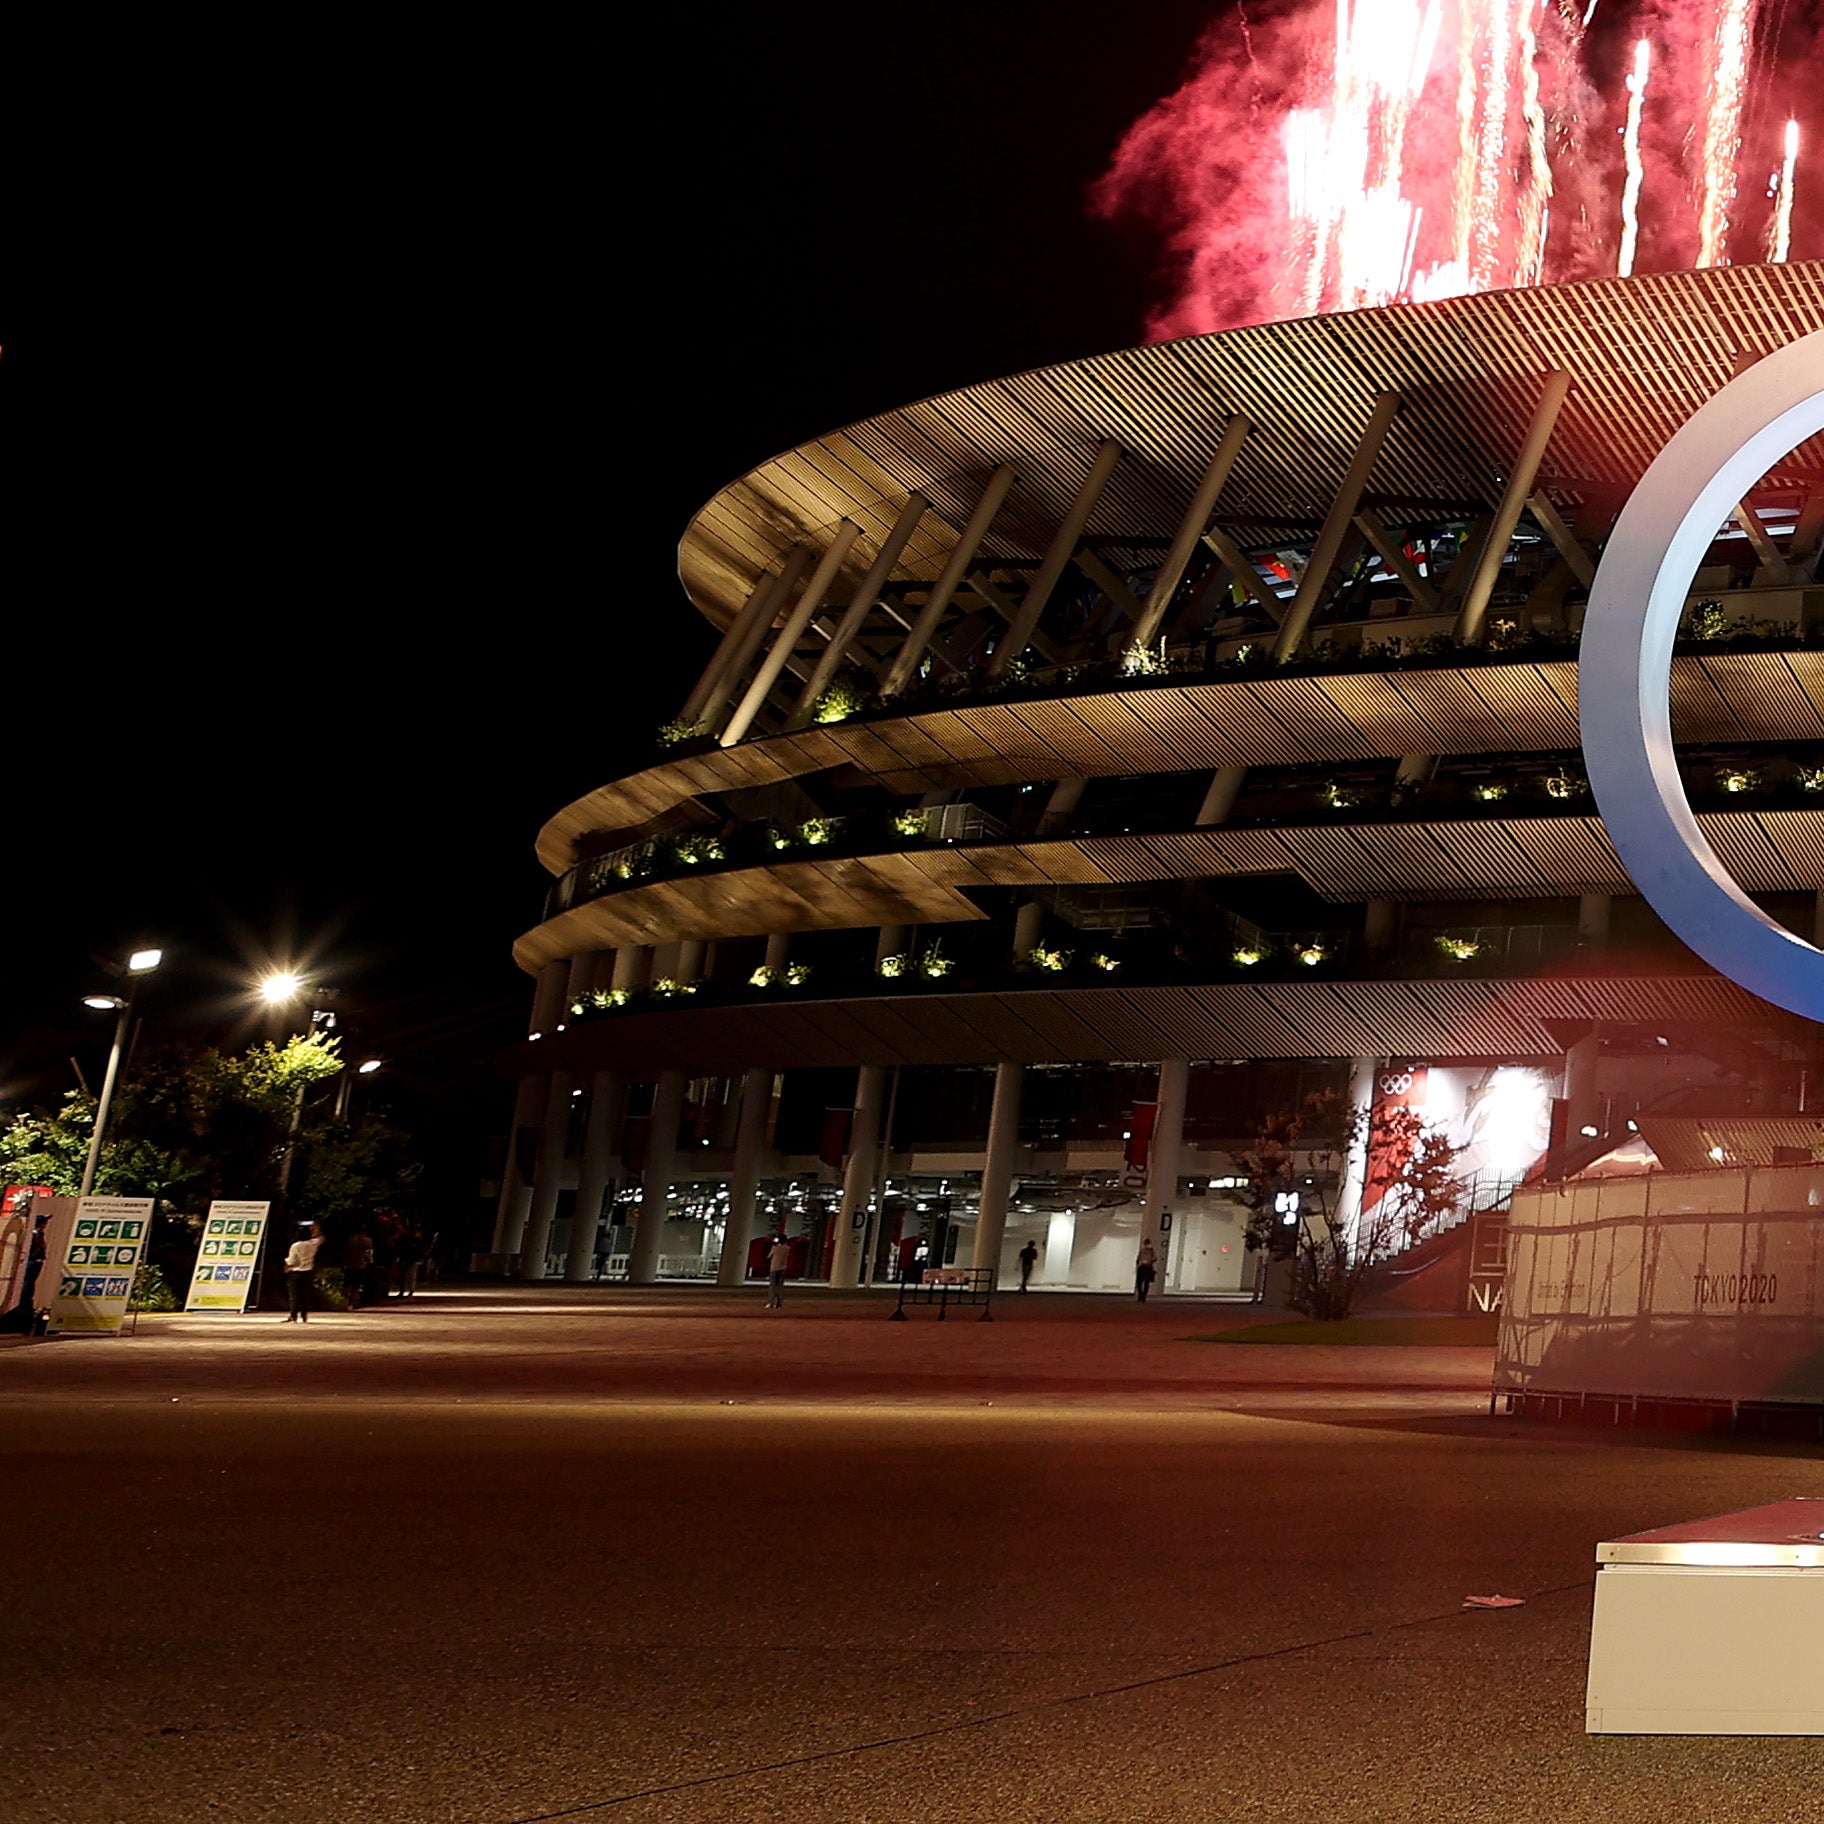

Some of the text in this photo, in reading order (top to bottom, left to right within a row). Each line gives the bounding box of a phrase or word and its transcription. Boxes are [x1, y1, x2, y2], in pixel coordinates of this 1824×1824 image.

[1160, 1213, 1173, 1231] D
[1694, 1273, 1778, 1304] TOKYO 2020
